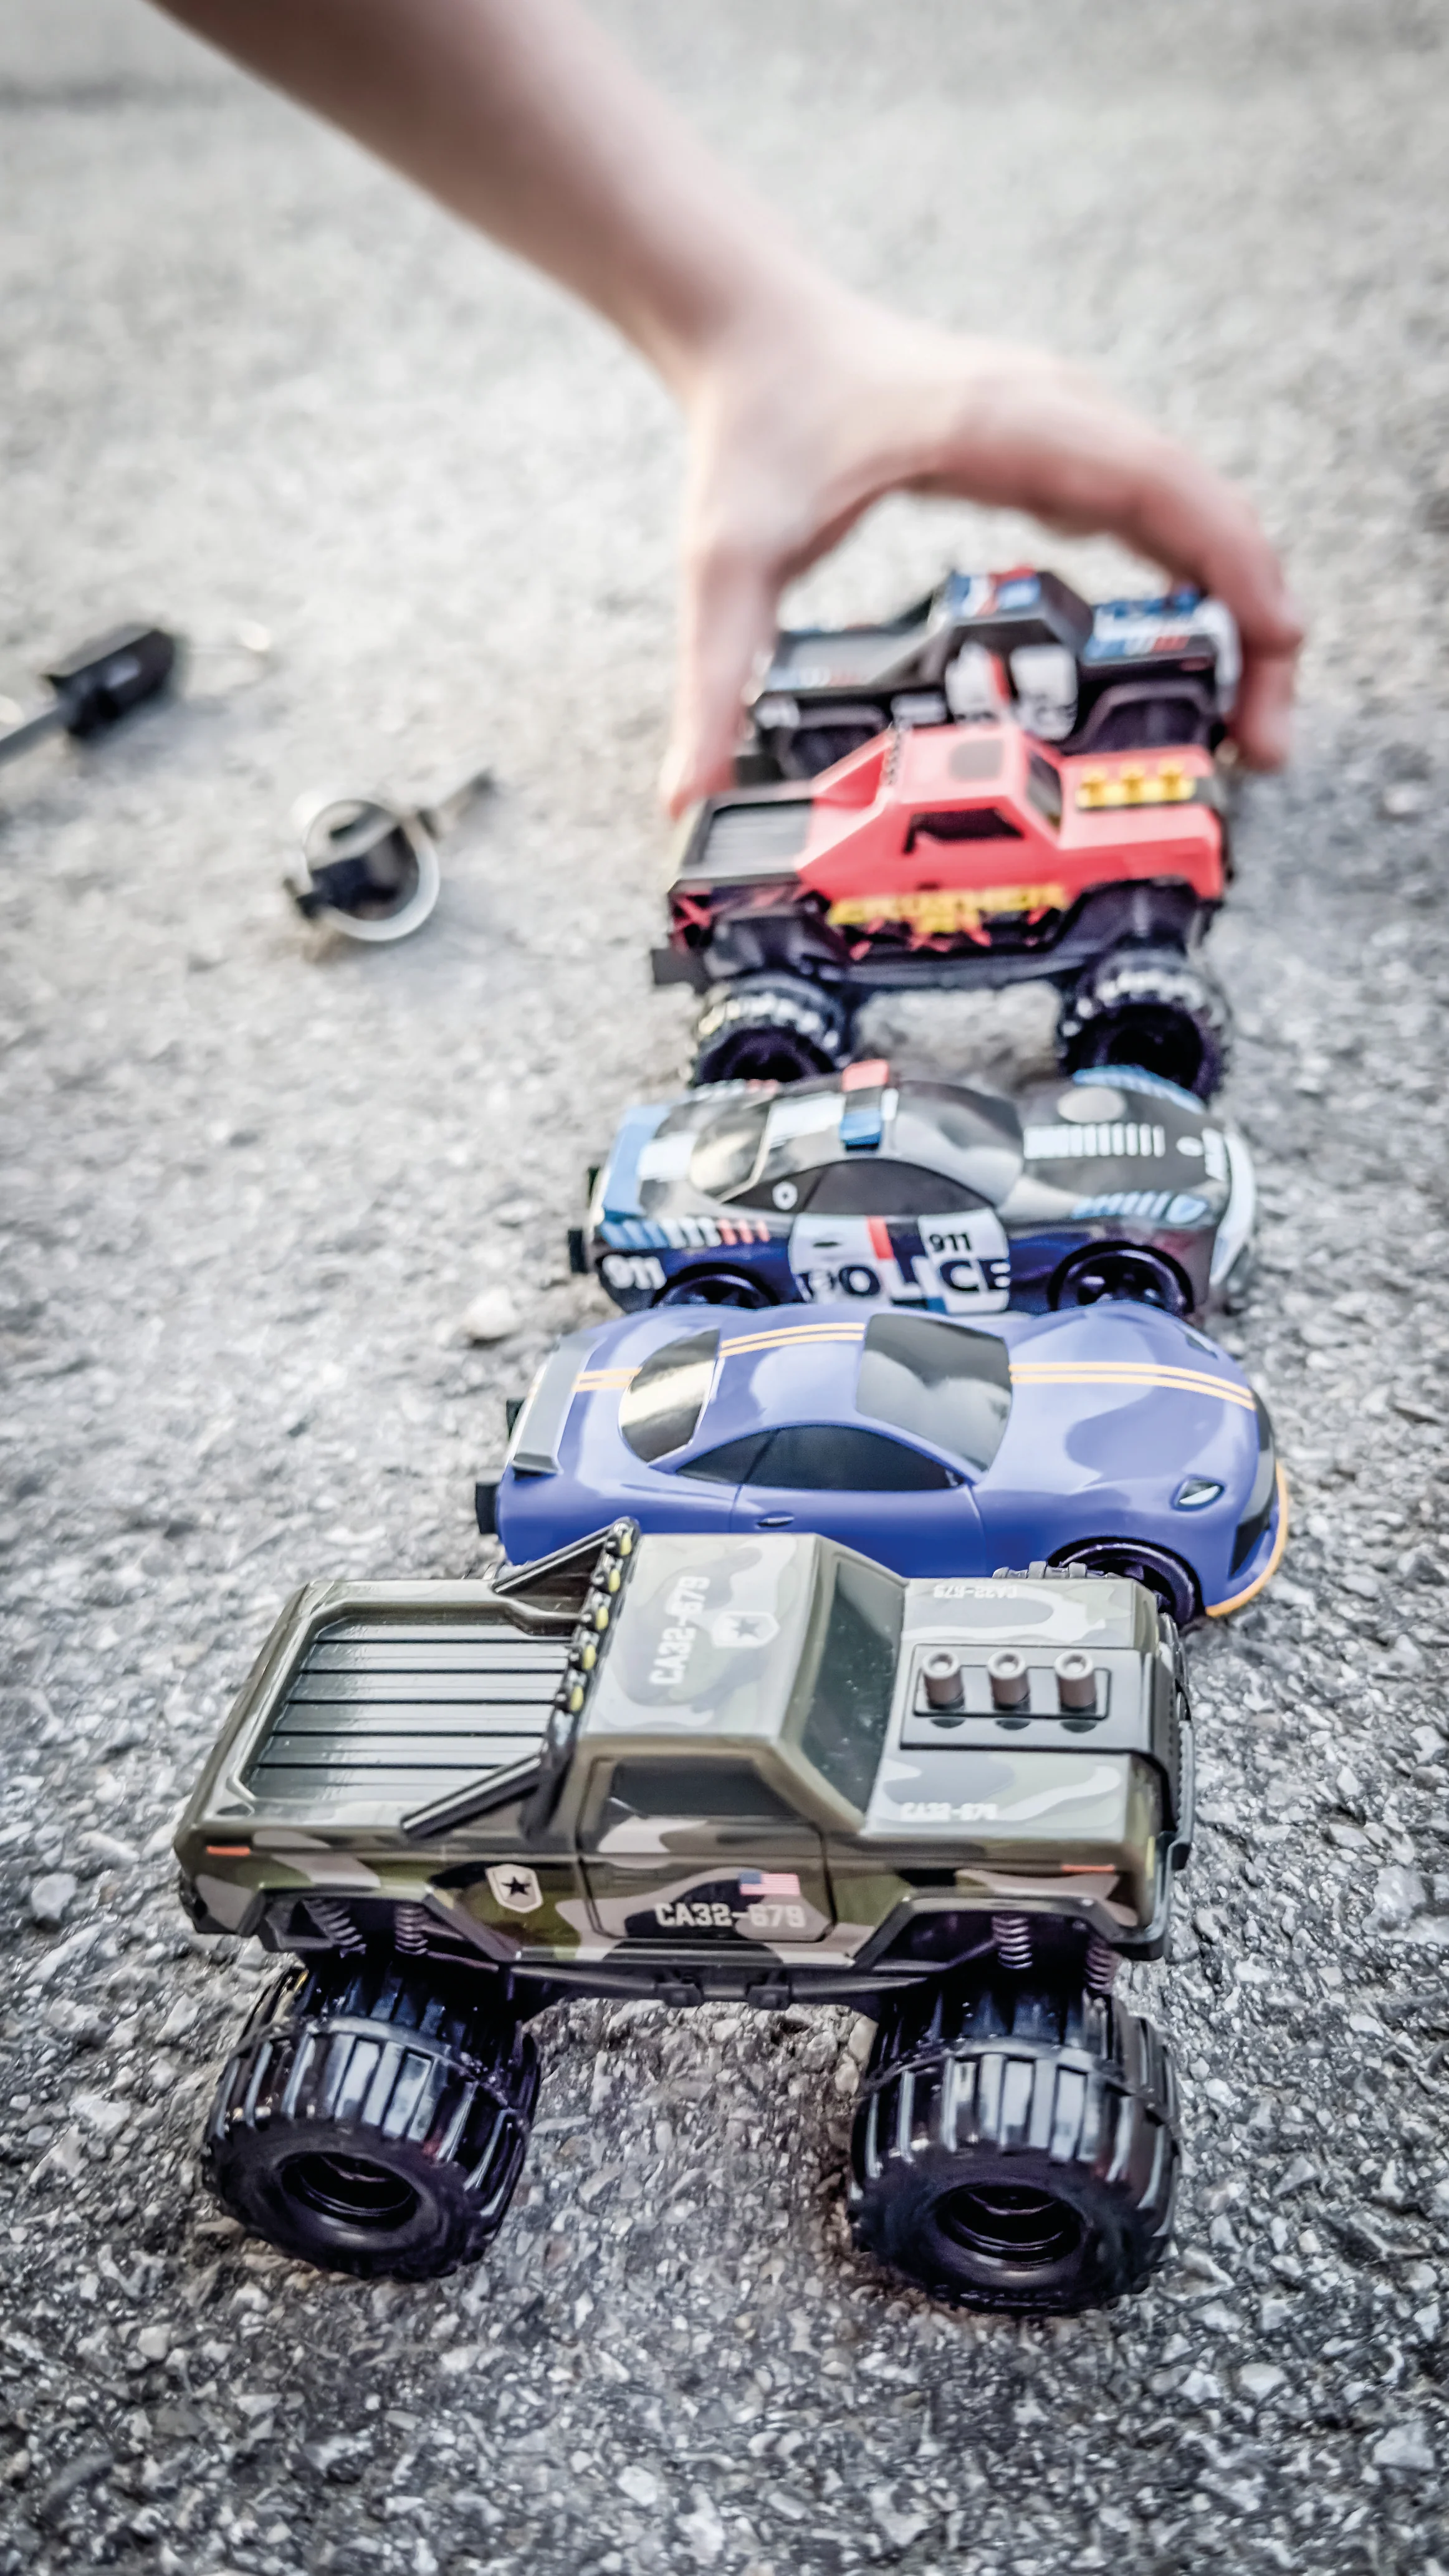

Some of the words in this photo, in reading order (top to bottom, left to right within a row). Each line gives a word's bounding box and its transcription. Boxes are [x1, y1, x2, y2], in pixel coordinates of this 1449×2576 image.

[929, 1233, 972, 1251] 911
[603, 1254, 667, 1290] 911
[649, 1576, 710, 1684] CA32-679
[655, 1902, 806, 1928] CA32-679
